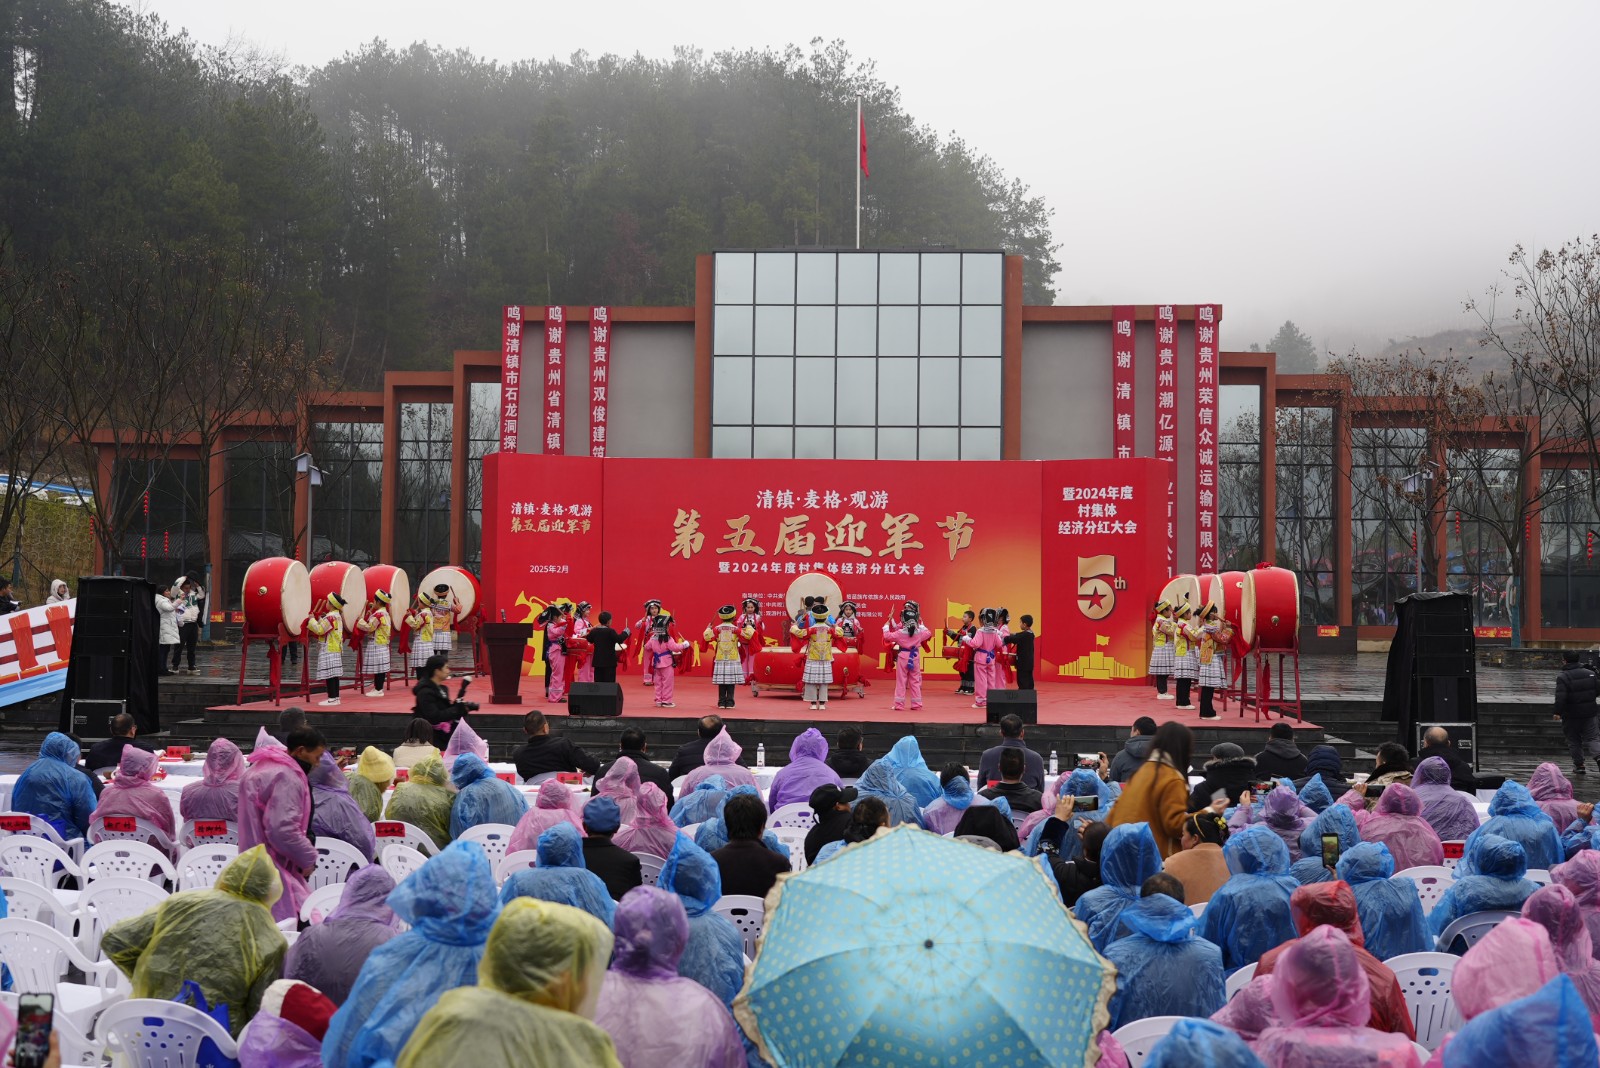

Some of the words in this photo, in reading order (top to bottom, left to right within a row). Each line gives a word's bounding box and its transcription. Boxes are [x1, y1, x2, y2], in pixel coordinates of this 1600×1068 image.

[503, 305, 521, 454] 鸣谢清镇市石龙洞探
[546, 306, 563, 450] 鸣谢贵州省清镇
[1116, 319, 1132, 459] 鸣谢清镇市
[1197, 306, 1215, 573] 鸣谢贵州荣信众诚运输有限公
[1062, 486, 1134, 501] 暨2024年度
[1077, 502, 1118, 517] 村集体
[669, 508, 976, 562] 第五届迎军节
[1058, 520, 1138, 535] 经济分红大会
[529, 565, 569, 574] 2025年2月
